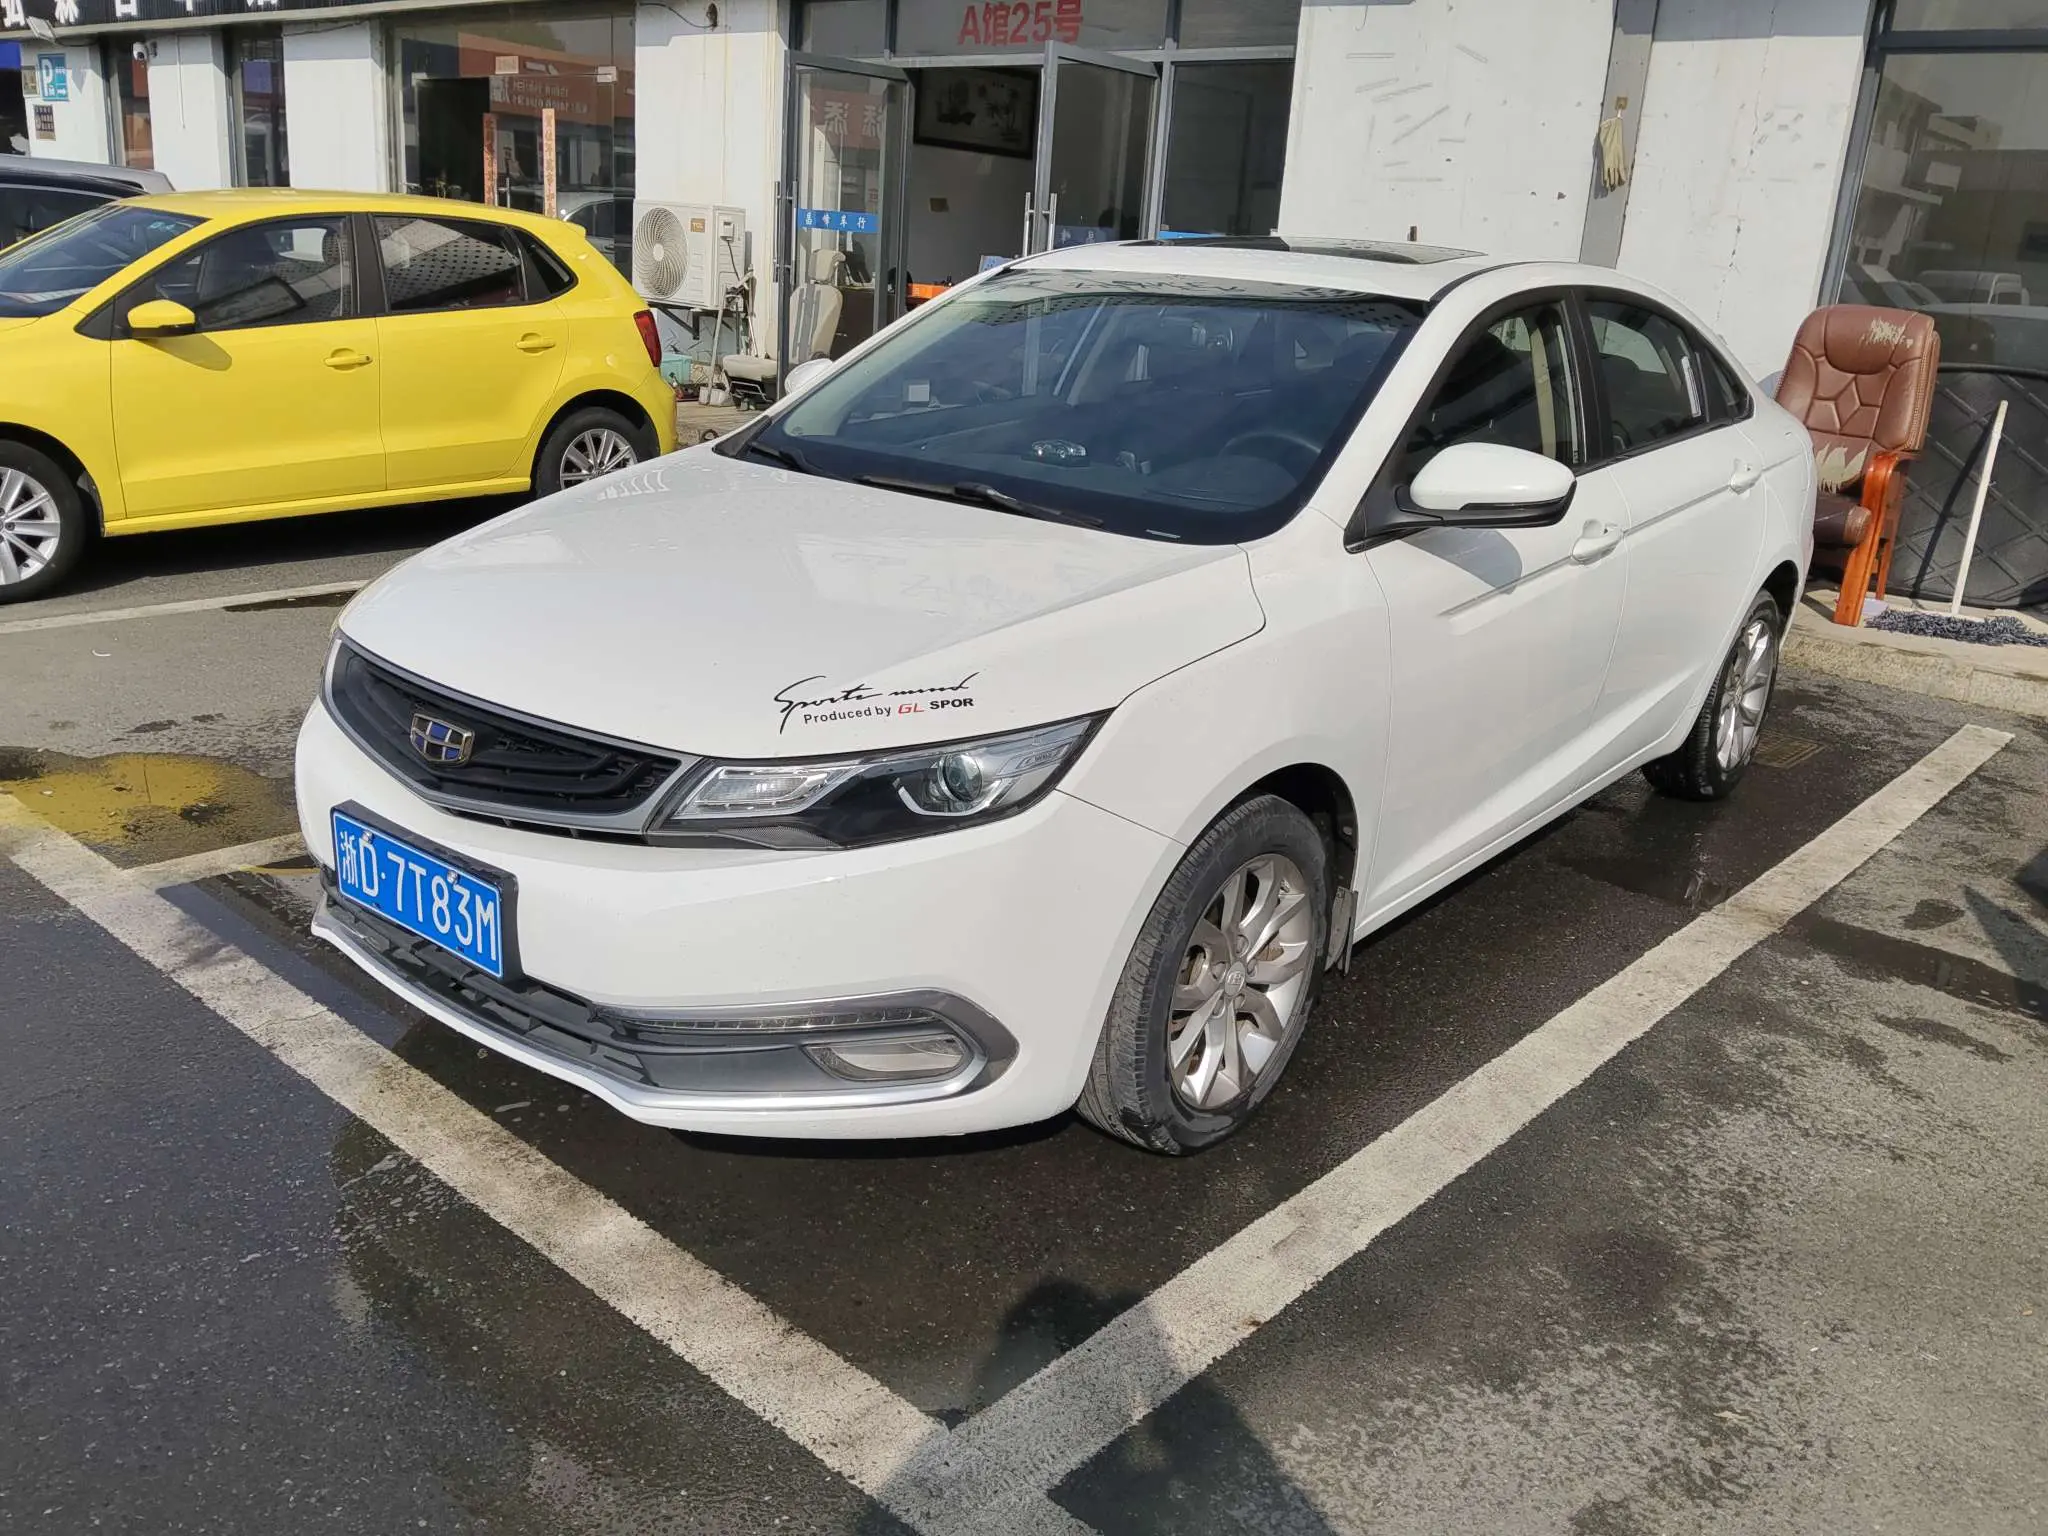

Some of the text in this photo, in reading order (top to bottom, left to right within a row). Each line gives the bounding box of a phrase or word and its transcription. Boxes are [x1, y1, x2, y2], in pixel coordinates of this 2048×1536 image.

[957, 0, 1083, 45] A馆25号
[803, 698, 974, 725] Produced by GL SPOR
